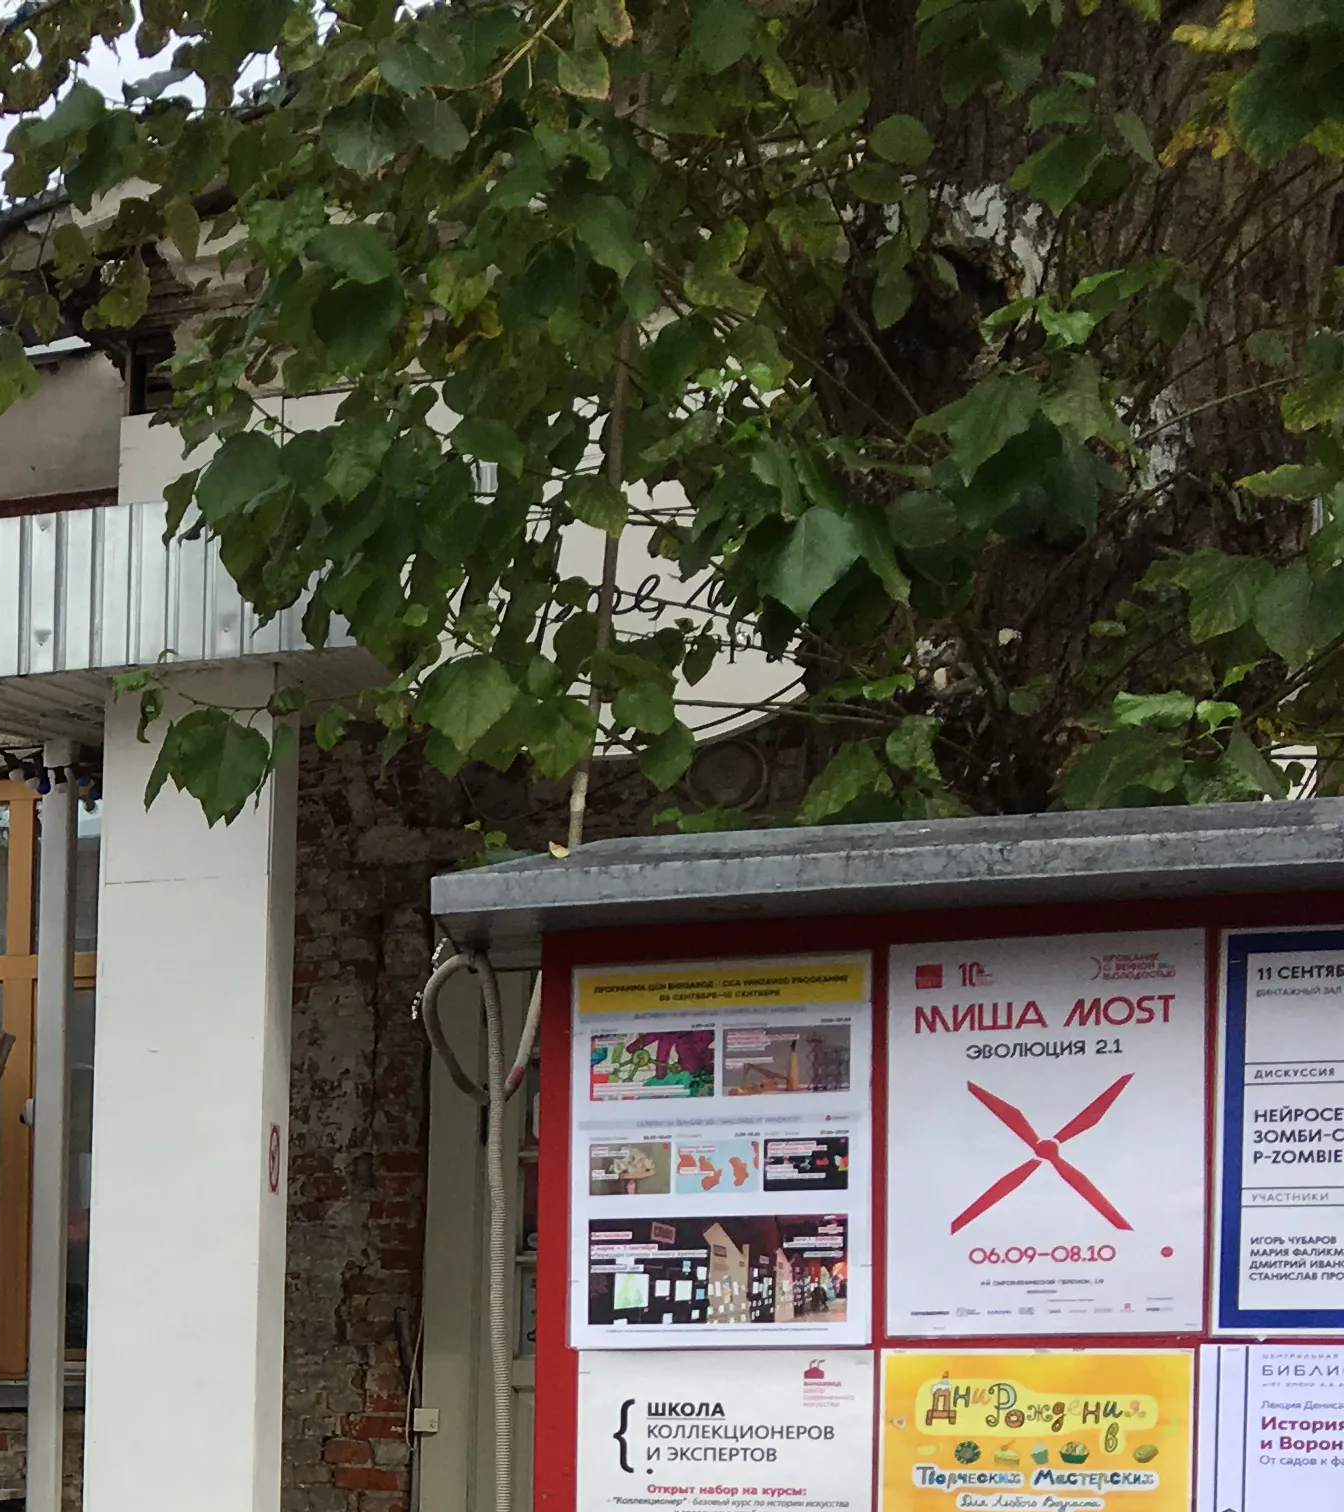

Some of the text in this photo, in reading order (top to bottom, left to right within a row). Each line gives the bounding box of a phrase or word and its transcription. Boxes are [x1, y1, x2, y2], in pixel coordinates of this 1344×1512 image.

[1257, 967, 1272, 980] 11
[1256, 985, 1342, 997] ВИНТАЖНЫЙ ЗАЛ
[915, 994, 1176, 1034] МИША MOST
[966, 1038, 1123, 1060] ЭВОЛЮЦИЯ 2.1
[1254, 1068, 1335, 1079] ДИСКУССИЯ
[1254, 1105, 1344, 1122] НЕЙРОСЕ
[1253, 1149, 1343, 1163] P-ZOMBIE
[1252, 1192, 1329, 1202] УЧАСТНИКИ
[1250, 1236, 1337, 1245] ИГОРЬ ЧУБАРОВ
[1250, 1247, 1344, 1257] МАРИЯ ФАЛИКМ
[1249, 1258, 1306, 1270] ДМИТРИЙ
[1249, 1272, 1317, 1281] СТАНИСЛАВ
[1262, 1364, 1344, 1376] БИБЛИ
[647, 1402, 725, 1417] ШКОЛА
[1261, 1401, 1301, 1410] Лекция
[1261, 1416, 1344, 1434] История
[647, 1424, 835, 1442] КОЛЛЕКЦИОНЕРОВ
[1260, 1439, 1273, 1450] и
[647, 1447, 777, 1462] И ЭКСПЕРТОВ
[1259, 1455, 1276, 1465] От
[1280, 1457, 1317, 1467] садов
[647, 1484, 807, 1497] Открыт набор на курсы:
